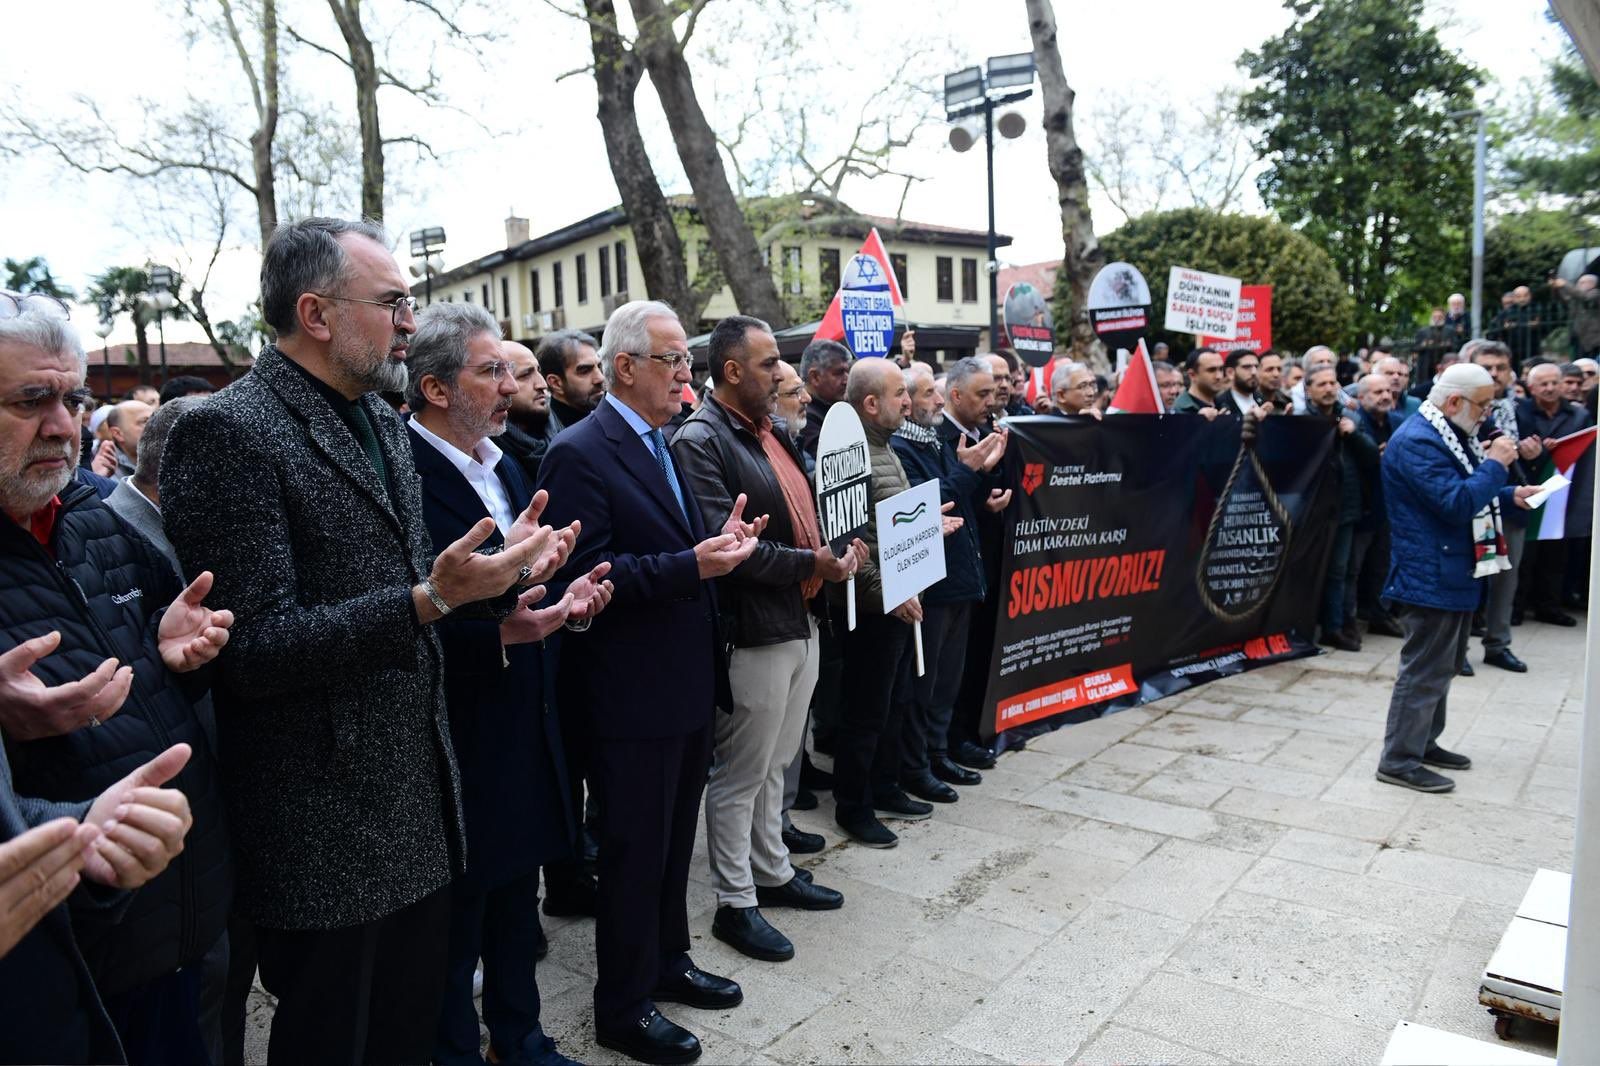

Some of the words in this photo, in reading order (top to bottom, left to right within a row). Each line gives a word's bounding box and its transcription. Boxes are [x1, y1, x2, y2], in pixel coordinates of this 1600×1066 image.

[1179, 280, 1231, 298] DÜNYANIN
[1171, 303, 1204, 317] SAVAŞ
[1207, 308, 1233, 322] SUÇU
[1185, 316, 1228, 333] İŞLİYOR
[854, 331, 888, 353] DEFOL
[1049, 474, 1082, 486] Destek
[1083, 472, 1122, 485] Platformu
[826, 482, 868, 541] HAYIR!
[1015, 514, 1089, 537] FİLİSTİN'DEKİ
[1014, 538, 1041, 556] İDAM
[1043, 533, 1097, 551] KARARINA
[1099, 528, 1127, 545] KARŞI
[1217, 527, 1280, 547] İNSANLIK
[1008, 550, 1166, 619] SUSMUYORUZ!
[1084, 672, 1112, 688] BURSA
